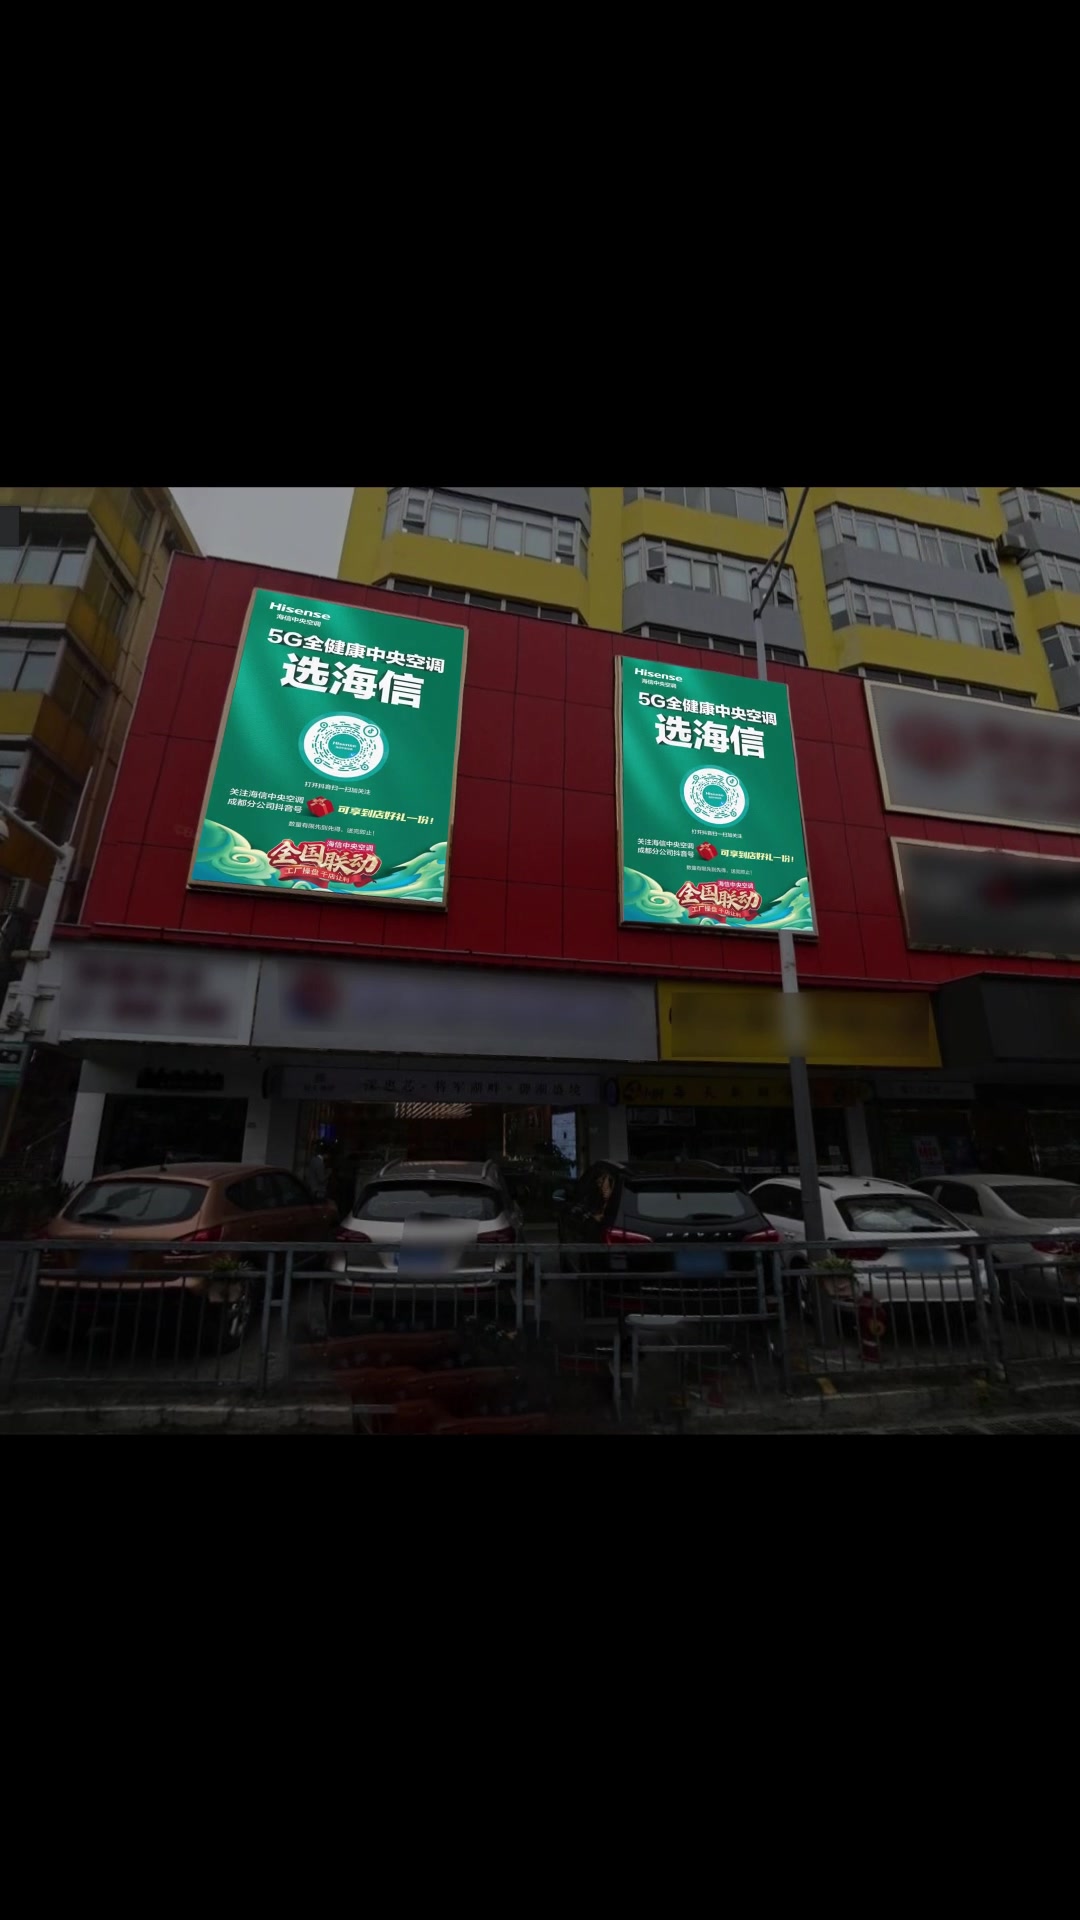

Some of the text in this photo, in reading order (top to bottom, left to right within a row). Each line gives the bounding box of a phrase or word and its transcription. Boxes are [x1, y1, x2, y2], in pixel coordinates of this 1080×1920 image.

[269, 602, 331, 621] Hisense
[276, 613, 321, 628] 海信中央空调
[267, 627, 445, 674] 5G全健康中央空调
[280, 653, 424, 709] 选海信
[634, 667, 683, 683] Hisense
[641, 678, 677, 689] 海信中央空调
[638, 691, 777, 726] 5G全健康中央空调
[654, 713, 765, 759] 选海信
[229, 788, 304, 804] 关注海信中央空调
[227, 798, 302, 814] 成都分公司抖音号
[326, 840, 374, 852] 海信中央空调
[637, 838, 694, 850] 关注海信中央空调
[270, 839, 378, 876] 全国联动
[637, 847, 694, 859] 成都分公司抖音号
[678, 881, 760, 911] 全国联动
